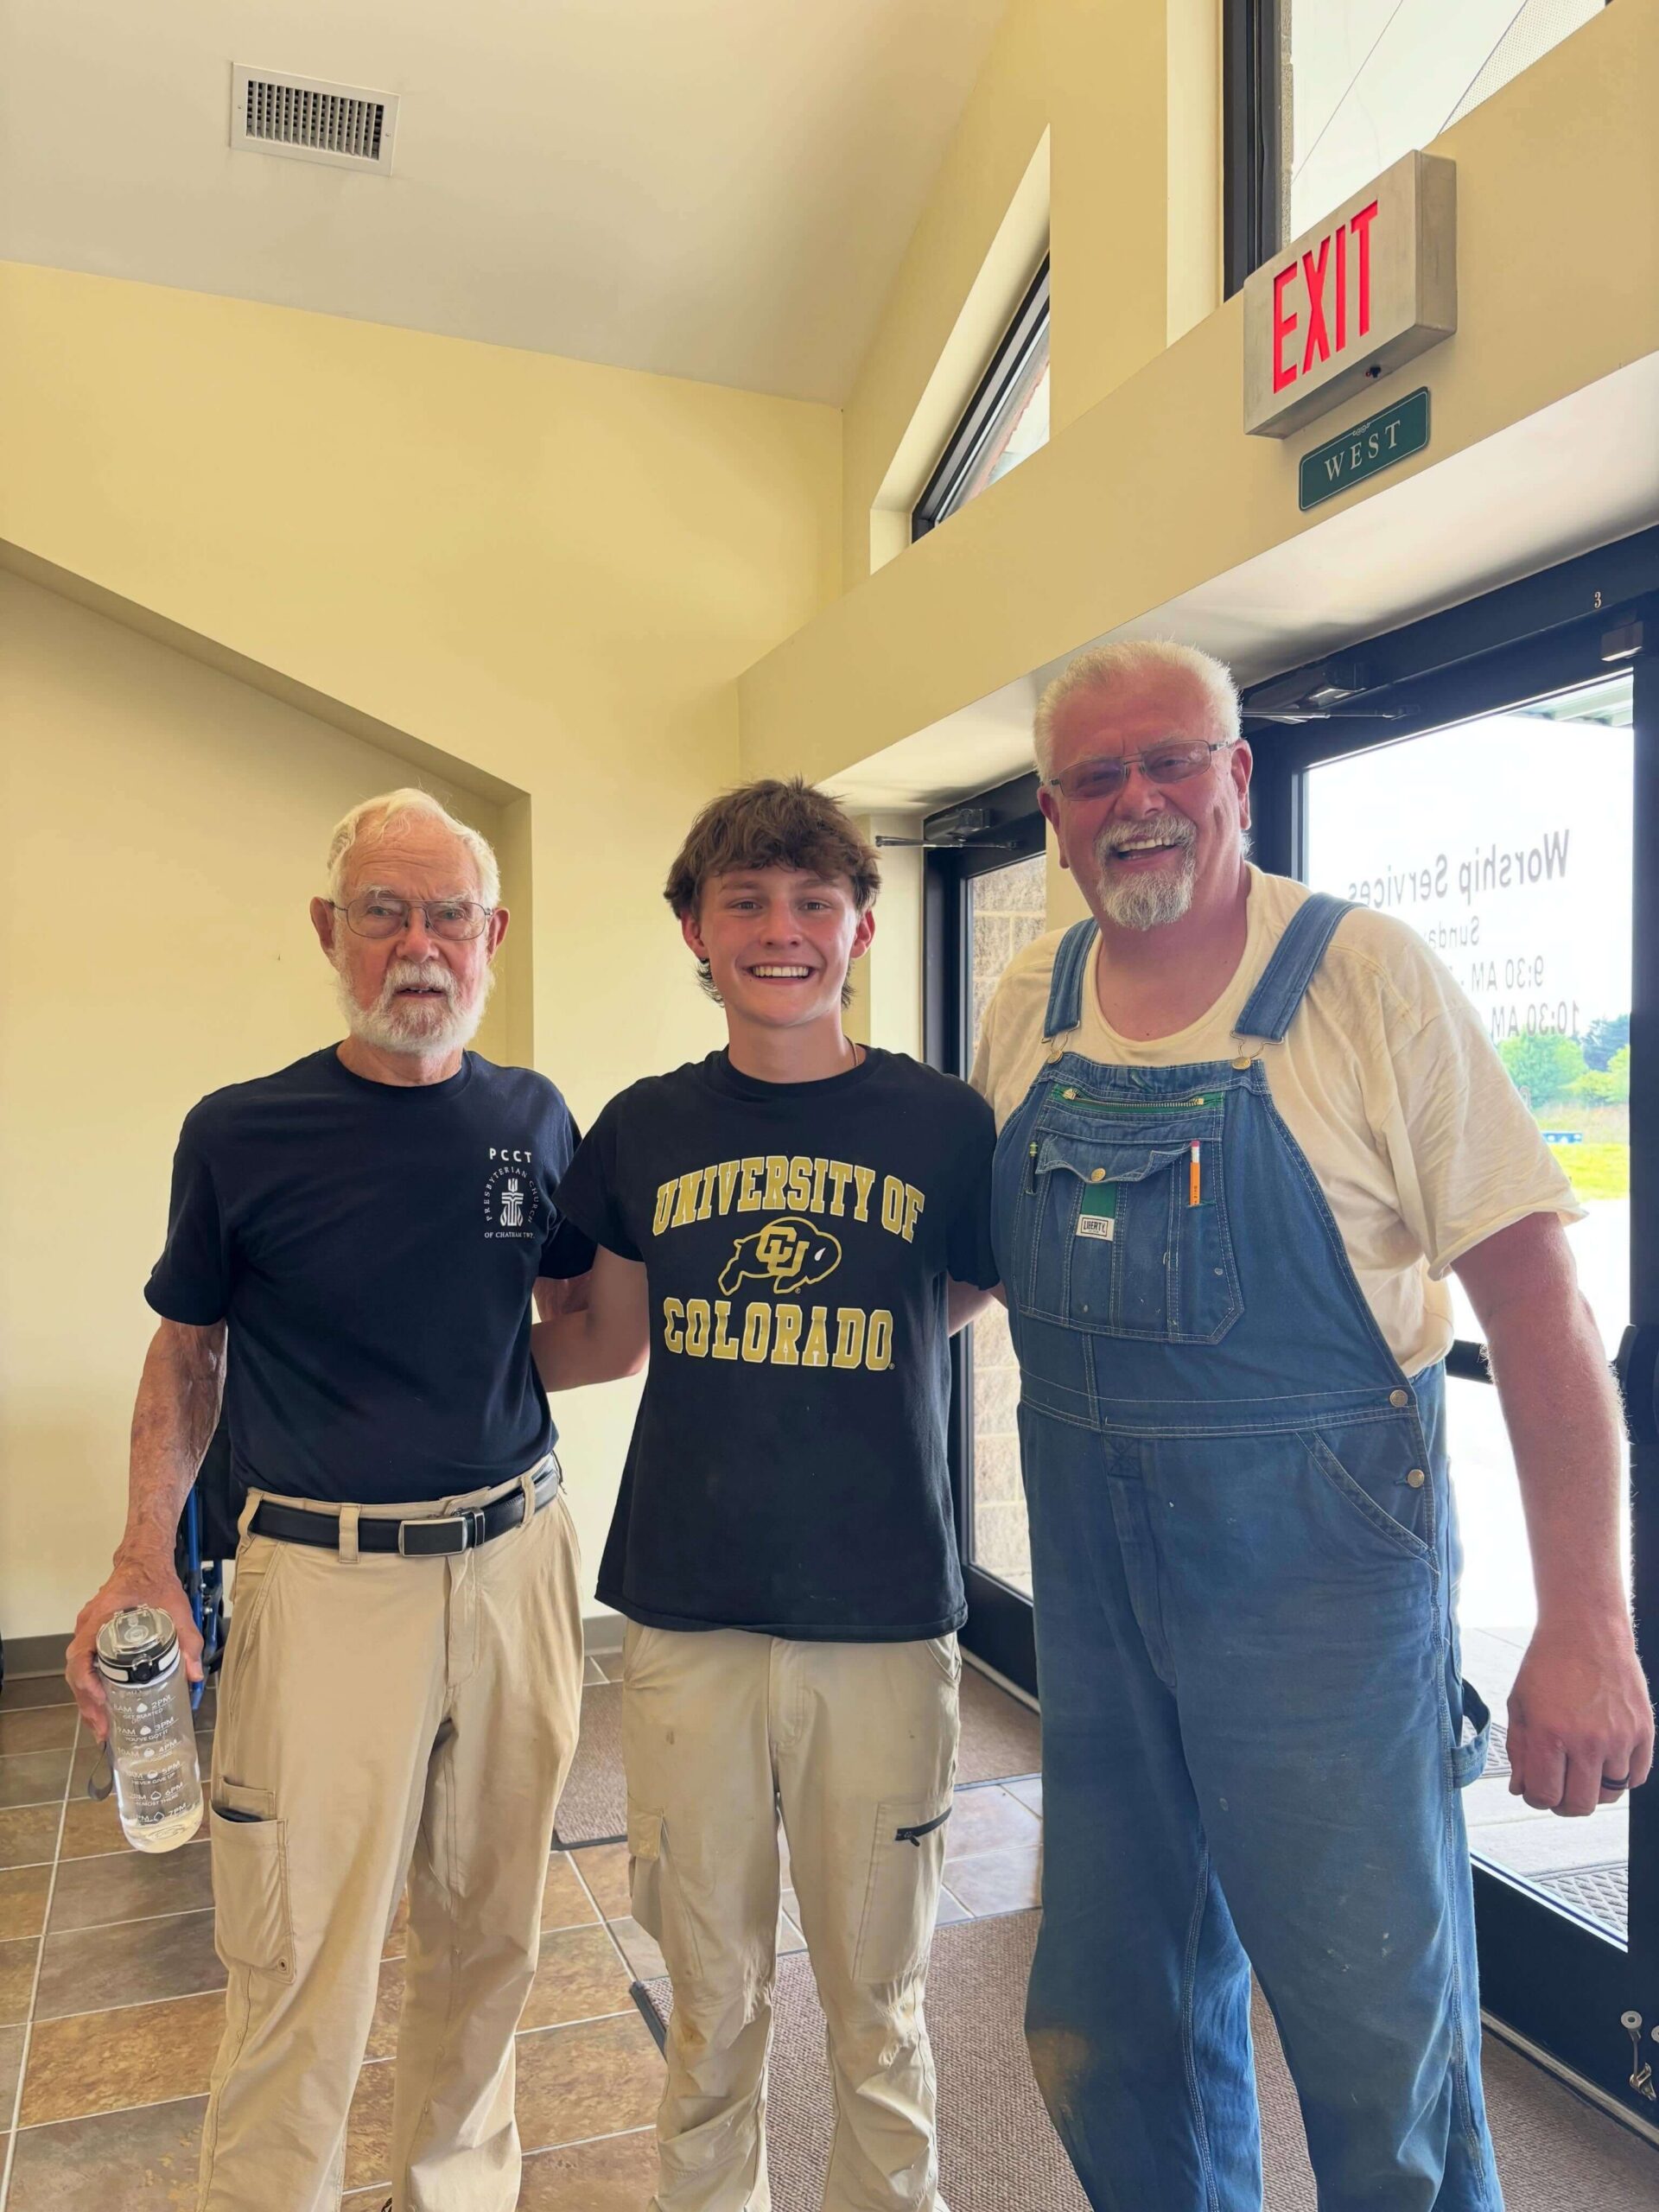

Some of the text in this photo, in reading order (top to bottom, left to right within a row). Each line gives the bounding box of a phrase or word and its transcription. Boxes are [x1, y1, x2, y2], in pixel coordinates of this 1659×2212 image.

[1273, 199, 1378, 394] EXIT
[1324, 420, 1402, 482] WEST
[1594, 591, 1602, 608] 3
[489, 1147, 532, 1163] PCCT
[484, 1166, 539, 1224] PRESBYTERIAN CHURCH
[652, 1155, 925, 1243] UNIVERSITY OF
[1084, 1220, 1106, 1233] LIBERTY
[755, 1226, 810, 1277] CU
[664, 1297, 893, 1370] COLORADO
[151, 1694, 172, 1709] 2PM
[154, 1716, 175, 1731] 3PM
[159, 1738, 178, 1753] 4PM
[162, 1760, 181, 1774] 5PM
[165, 1782, 184, 1796] 6PM
